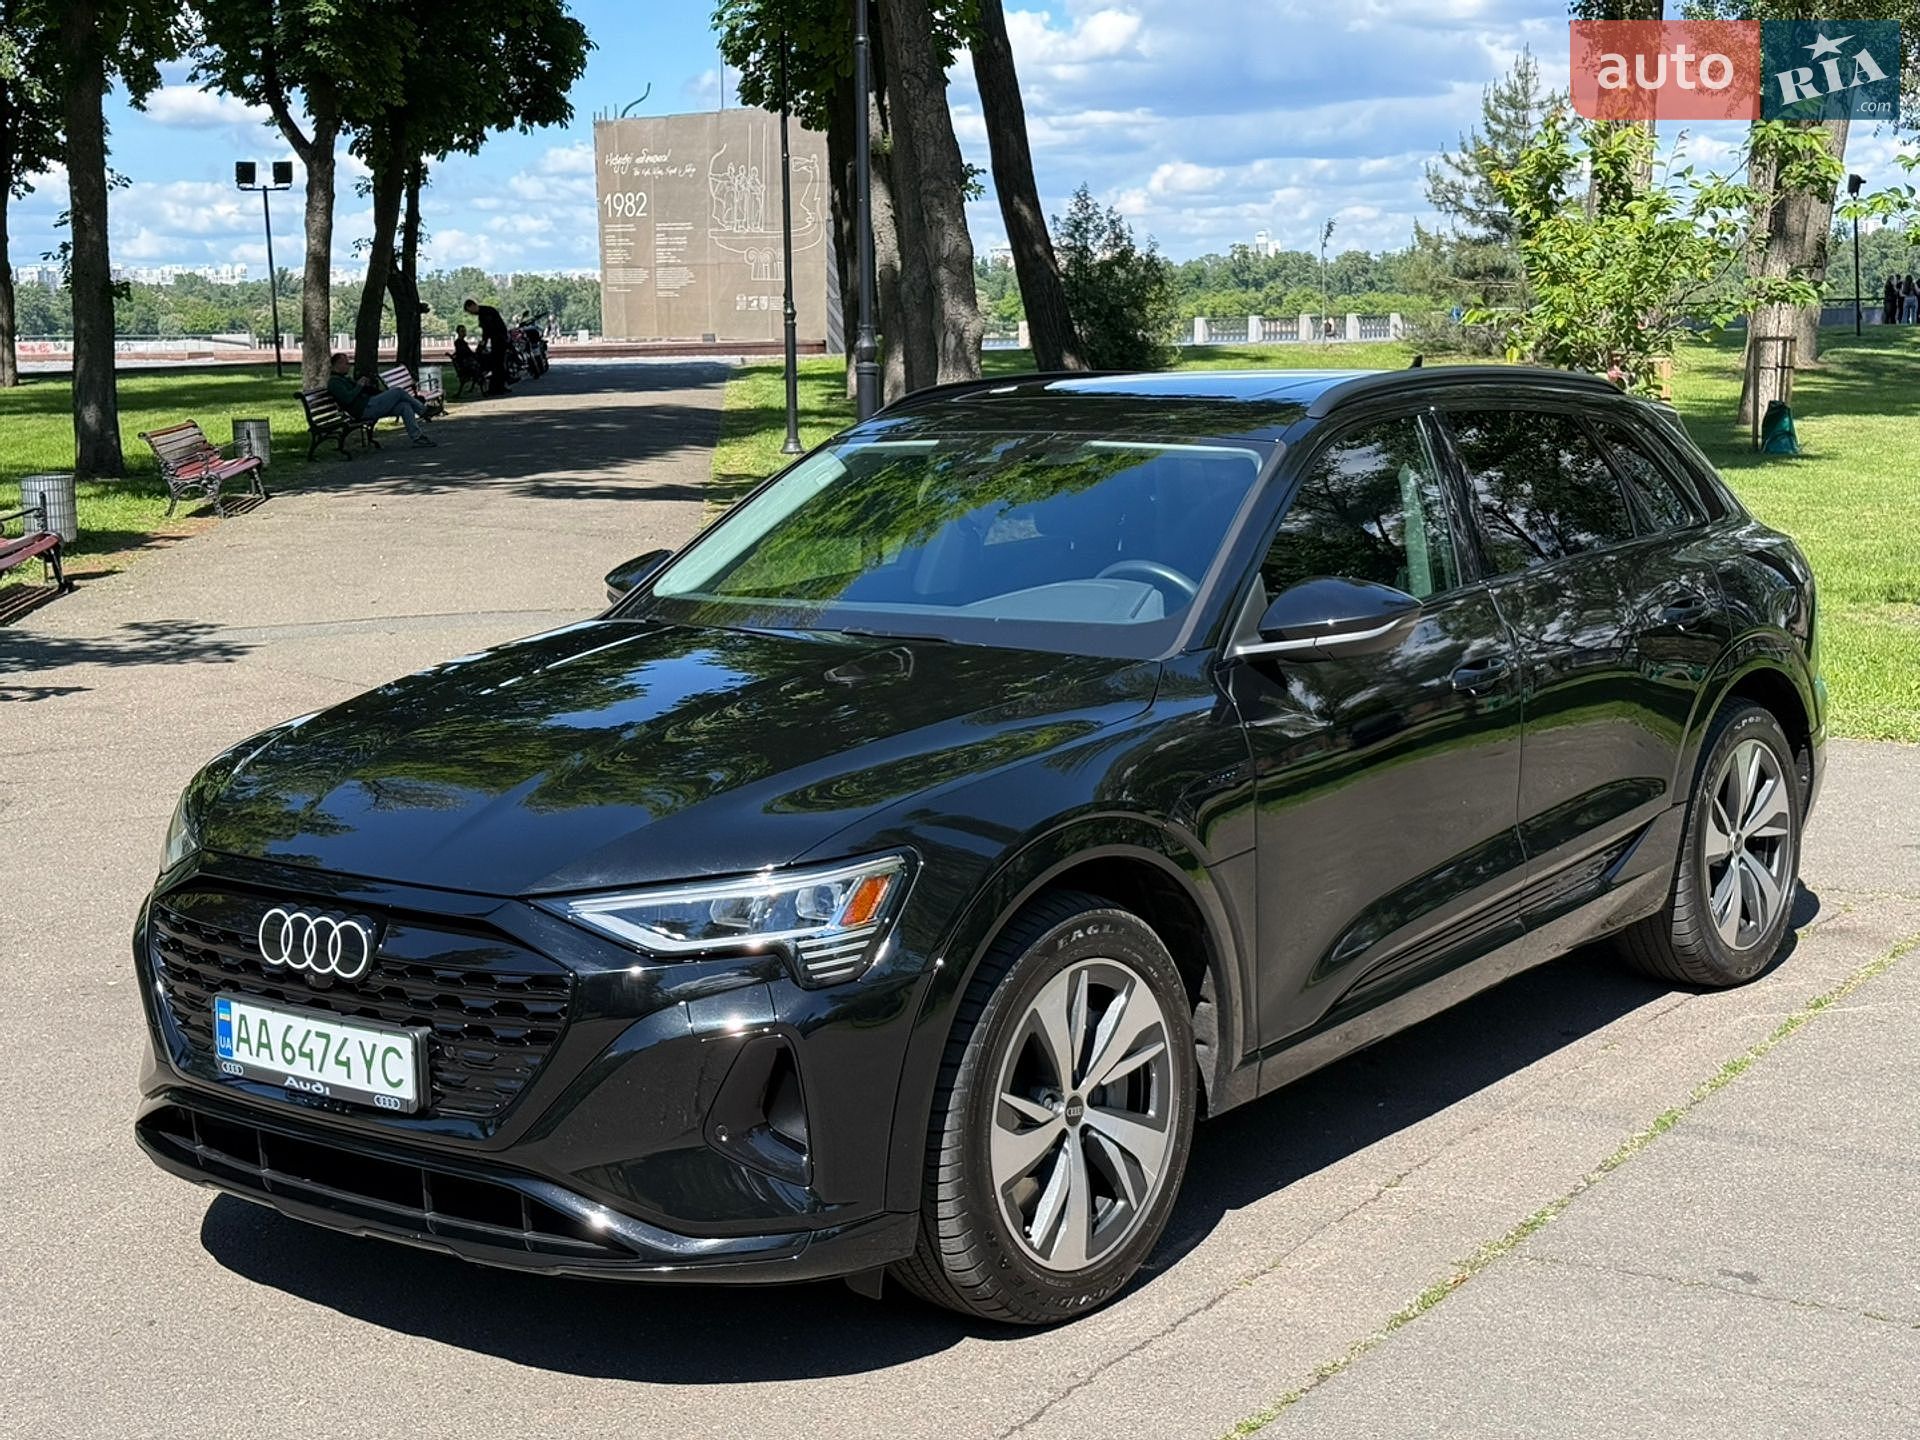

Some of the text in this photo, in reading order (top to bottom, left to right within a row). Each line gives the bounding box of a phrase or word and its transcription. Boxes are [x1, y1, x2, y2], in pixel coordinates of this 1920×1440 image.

[604, 192, 648, 217] 1982
[219, 1035, 232, 1050] UA
[236, 1013, 404, 1089] AA 6474 YC
[284, 1076, 331, 1096] Audi
